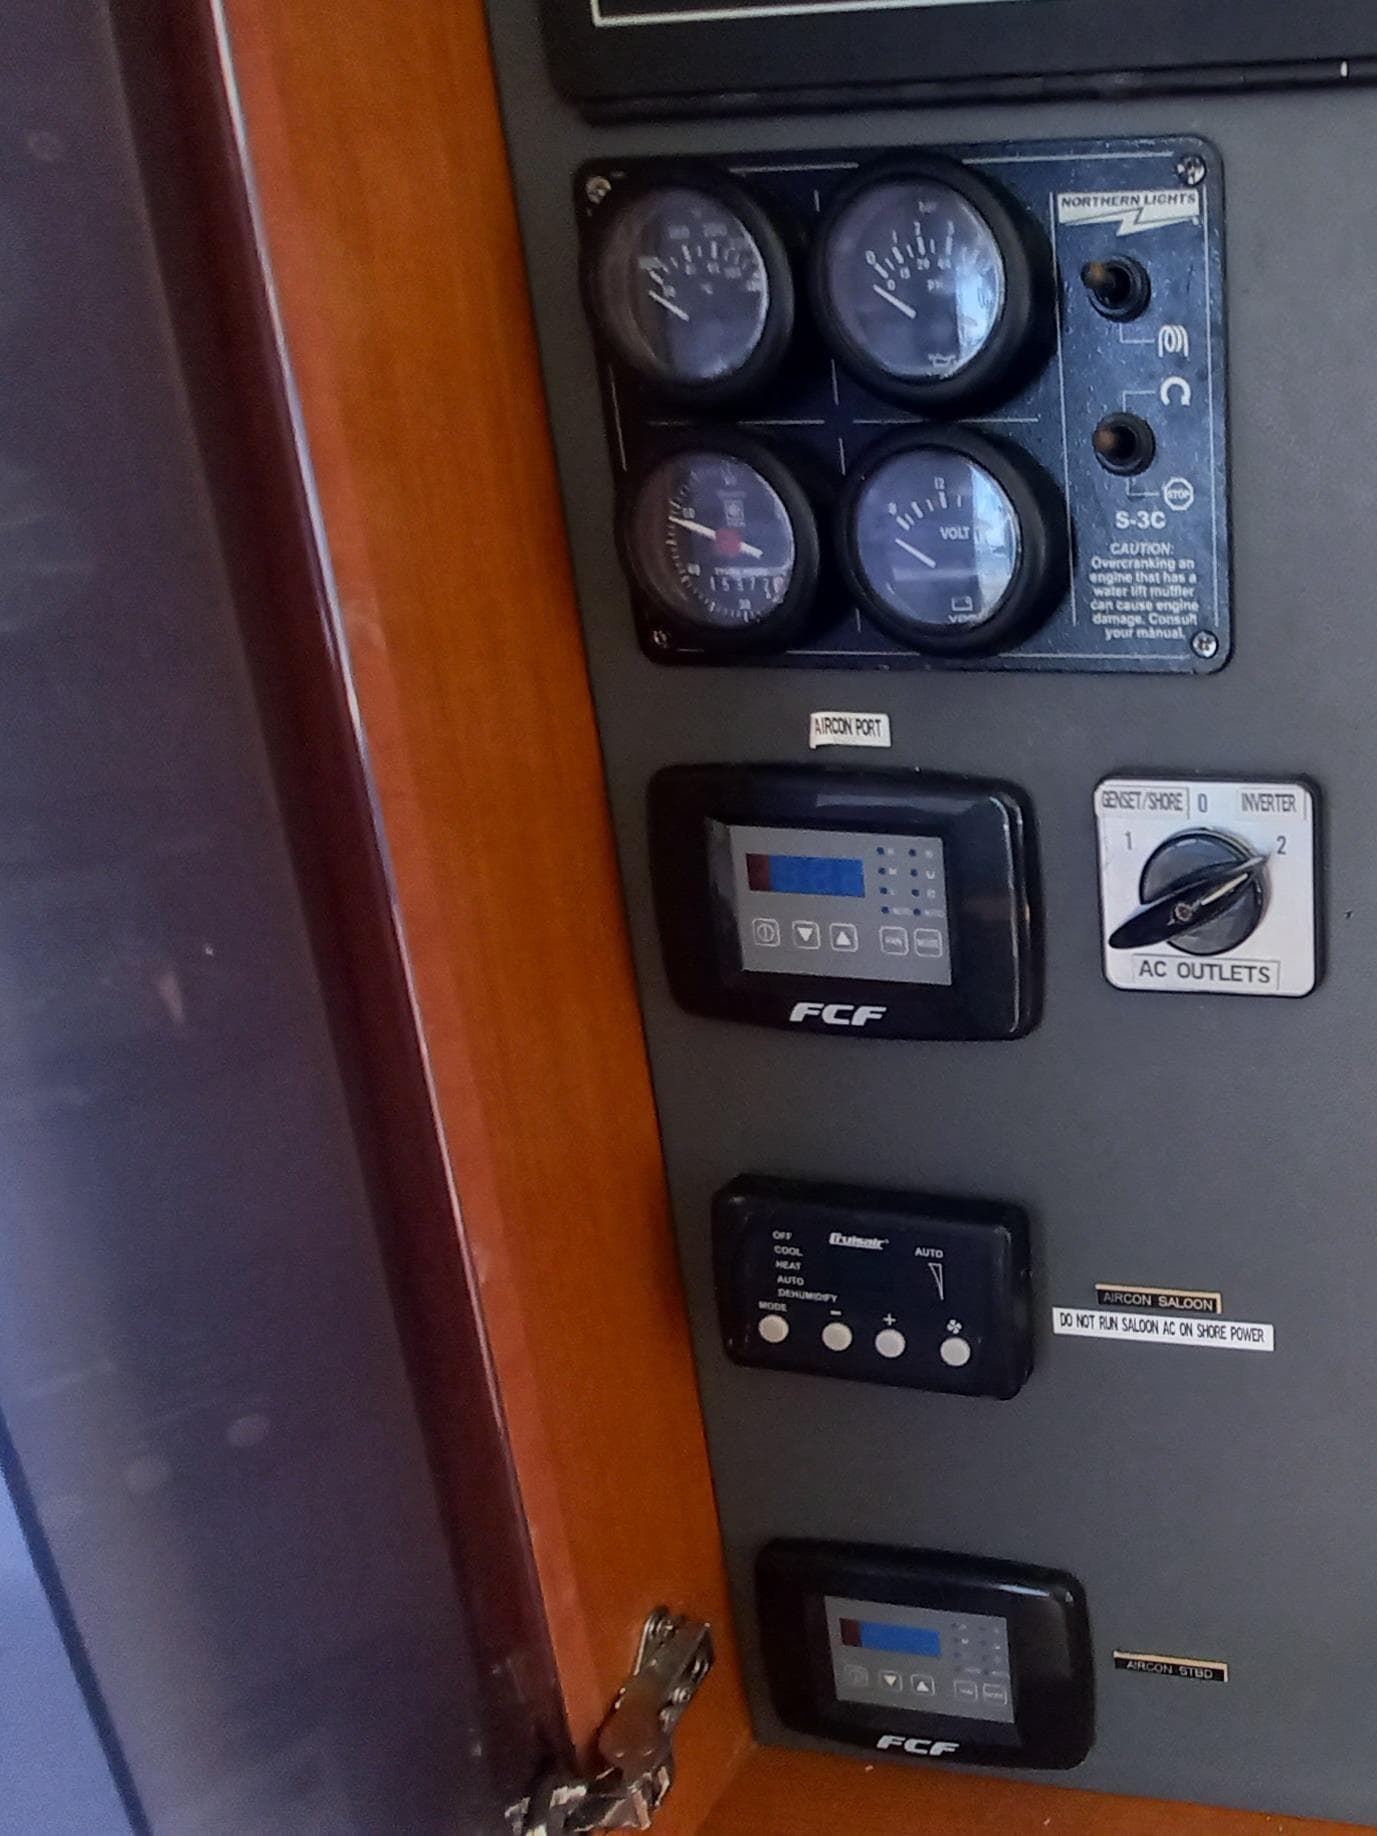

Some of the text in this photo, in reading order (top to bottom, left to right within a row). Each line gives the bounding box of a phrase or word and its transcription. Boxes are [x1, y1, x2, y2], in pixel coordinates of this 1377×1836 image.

[1061, 193, 1196, 207] NORTHERN LIGHTS
[1115, 511, 1166, 529] S-3C
[940, 526, 970, 540] VOLT
[1110, 542, 1175, 555] CAUTION:
[1091, 557, 1195, 571] Overcranking an
[1089, 572, 1197, 585] engine that has a
[1093, 586, 1195, 597] water lift muffler
[1090, 601, 1199, 612] can cause engine
[1092, 613, 1198, 627] damage. Consult
[1105, 629, 1134, 641] your
[814, 717, 882, 737] AIRCON PORT
[1102, 790, 1184, 812] GENSET/SHORE
[1242, 793, 1297, 812] INVERTER
[1124, 832, 1287, 855] 1 2
[1139, 960, 1271, 984] AC OUTLETS
[789, 1001, 887, 1028] FCF
[772, 1229, 792, 1241] OFF
[774, 1245, 803, 1256] COOL
[915, 1247, 944, 1259] AUTO
[775, 1260, 801, 1270] HEAT
[777, 1275, 805, 1286] AUTO
[777, 1288, 838, 1303] DEHUMIDIFY
[1103, 1292, 1213, 1311] AIRCON SALOON
[758, 1301, 787, 1312] MODE
[1060, 1312, 1264, 1343] DO NOT RUN SALOON AC ON SHORE POWER
[1127, 1660, 1172, 1674] AIRCON
[876, 1734, 959, 1756] FCF
